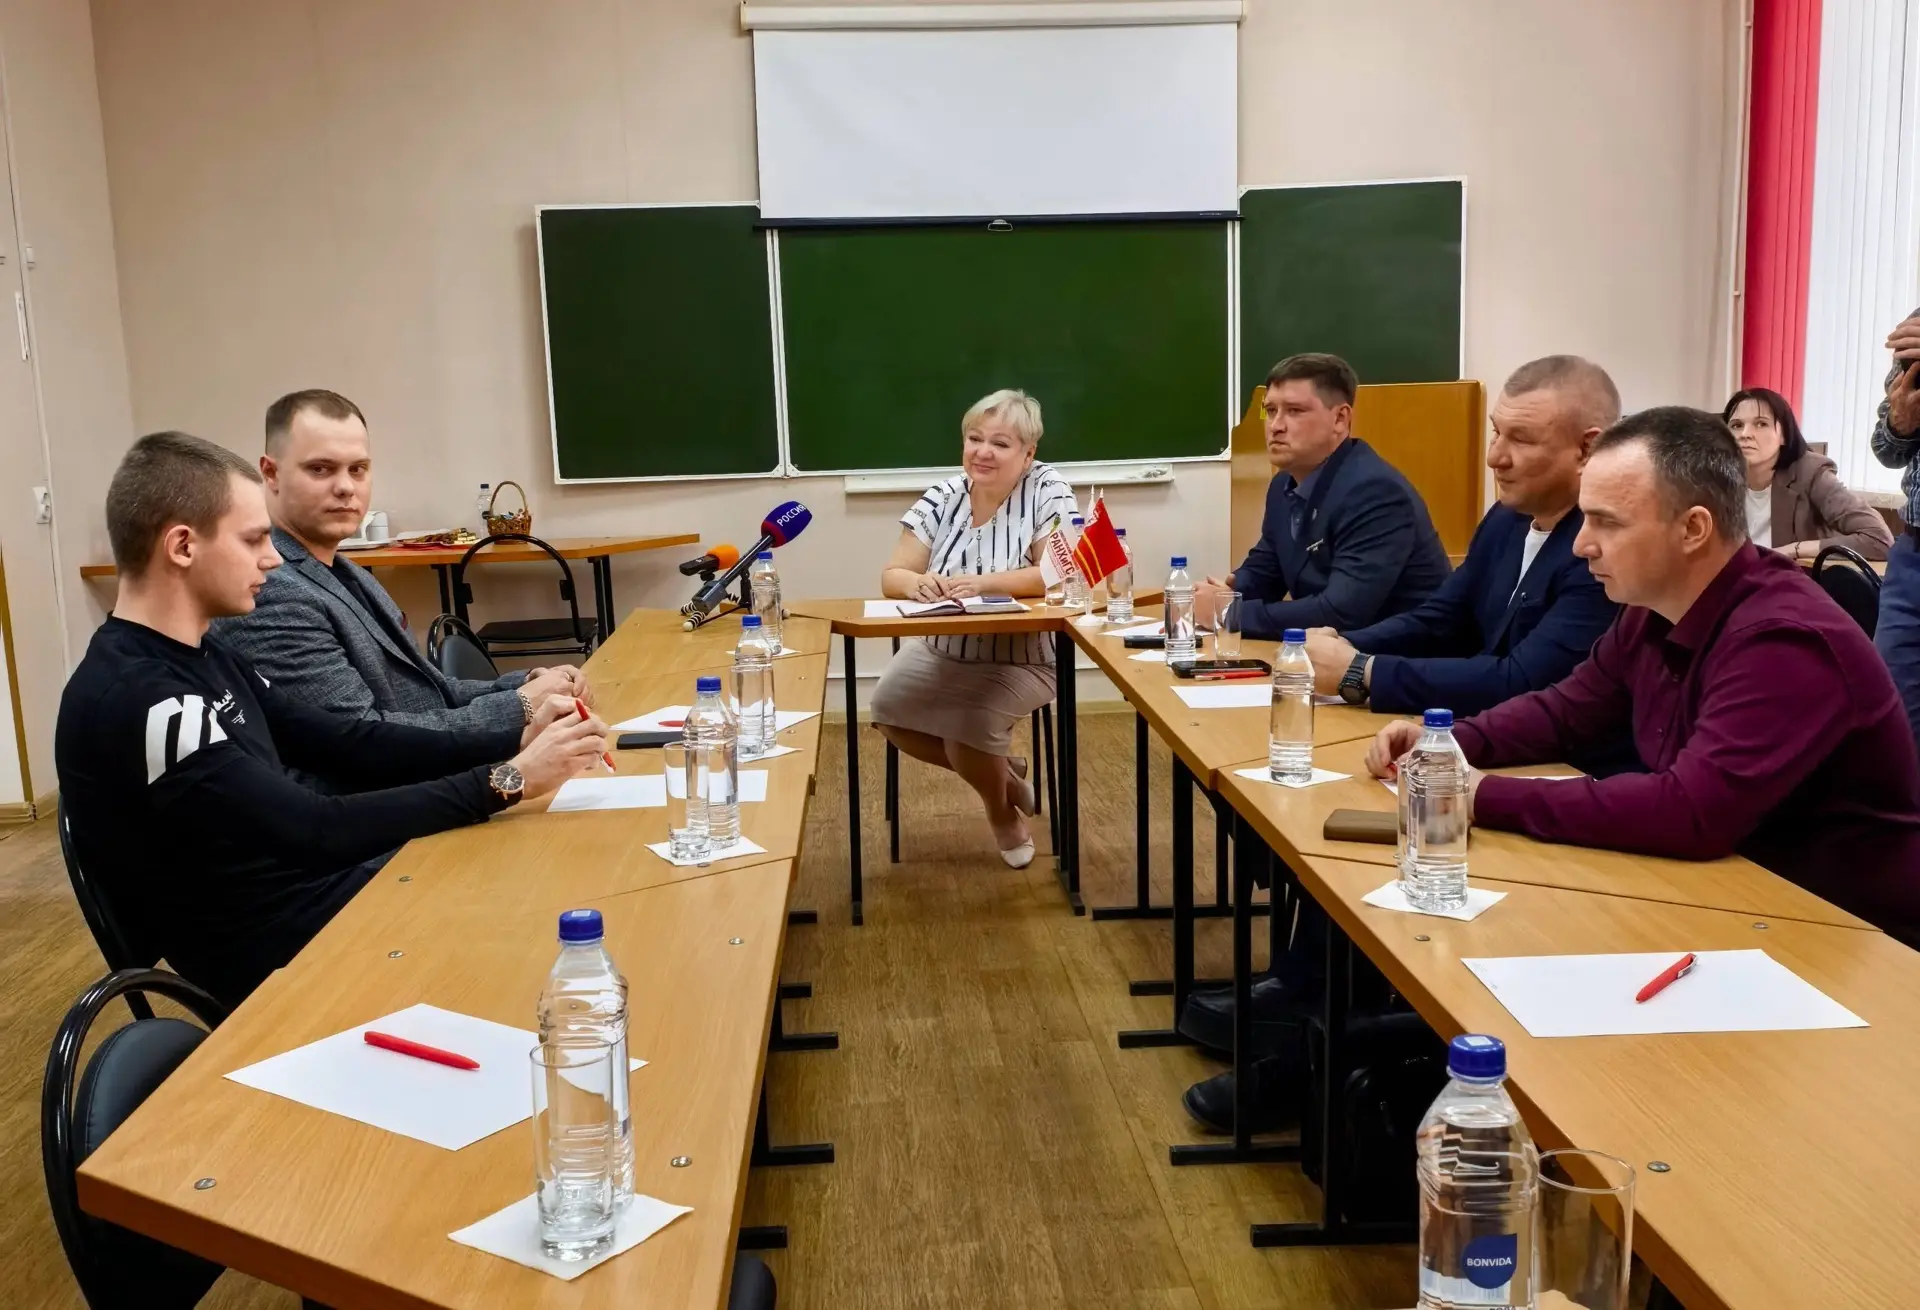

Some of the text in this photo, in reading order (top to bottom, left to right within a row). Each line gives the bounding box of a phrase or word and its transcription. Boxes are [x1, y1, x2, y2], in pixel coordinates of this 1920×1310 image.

[776, 504, 807, 527] РОССИЯ
[1049, 531, 1075, 575] РАНХиГС
[1466, 1257, 1513, 1267] BONVIDA
